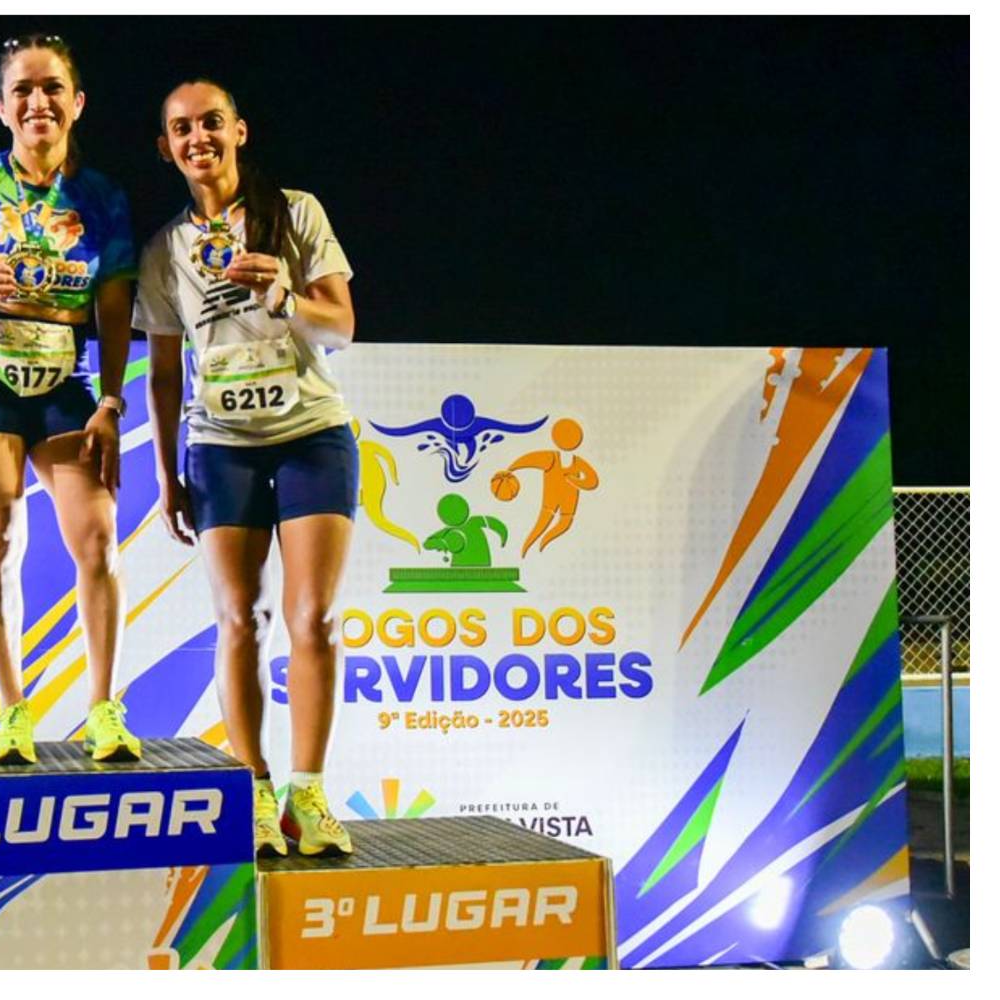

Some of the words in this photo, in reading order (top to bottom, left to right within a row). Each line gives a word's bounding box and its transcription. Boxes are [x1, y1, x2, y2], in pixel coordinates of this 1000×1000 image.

[5, 364, 62, 388] 6177
[221, 385, 285, 411] 6212
[343, 608, 487, 648] OGOS
[512, 606, 616, 646] DOS
[270, 652, 653, 704] SRVIDORES
[405, 710, 479, 734] Edição
[498, 709, 549, 728] 2025
[459, 803, 538, 812] PREFEITURA
[544, 802, 559, 810] DE
[301, 898, 355, 938] 3º
[363, 886, 578, 935] LUGAR
